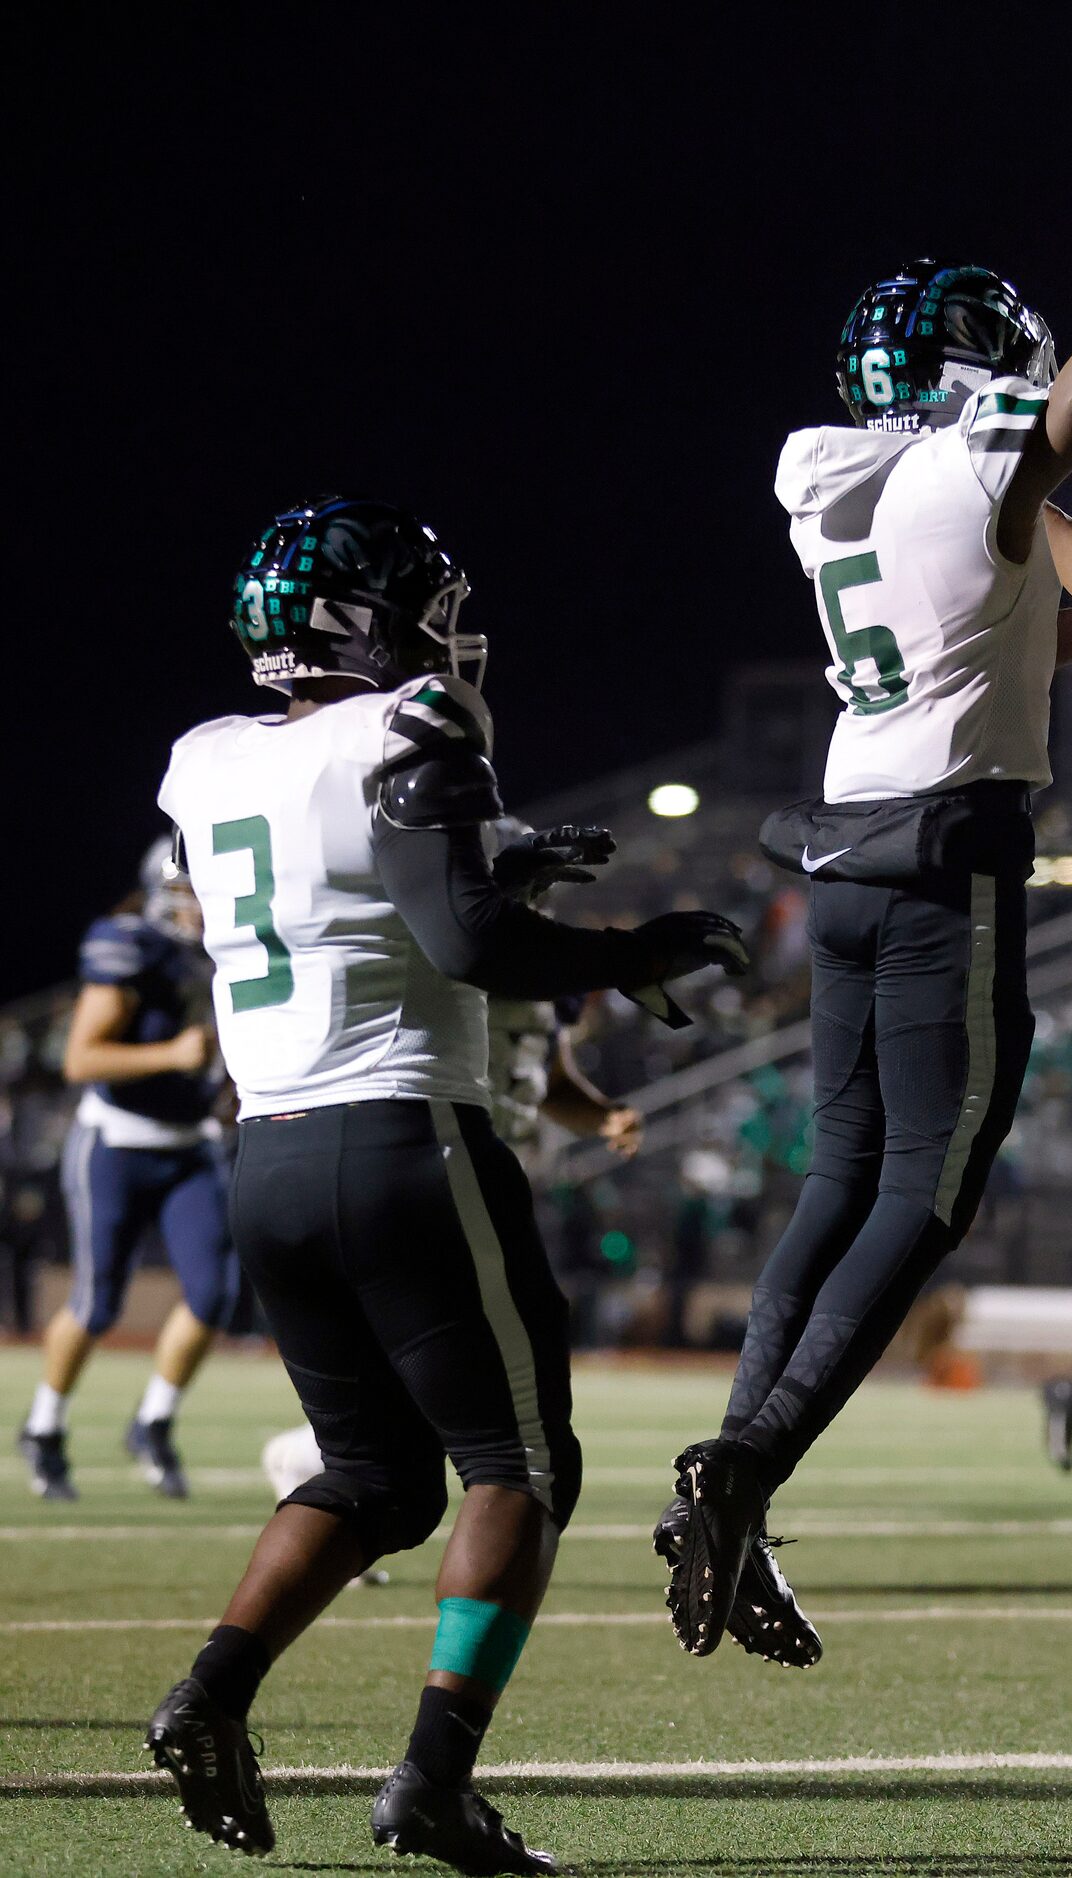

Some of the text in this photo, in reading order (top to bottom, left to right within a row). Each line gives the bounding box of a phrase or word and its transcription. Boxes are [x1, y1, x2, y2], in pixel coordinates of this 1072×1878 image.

[849, 356, 858, 374] B
[893, 349, 907, 366] B
[861, 349, 895, 406] 6
[919, 391, 948, 402] BRT
[867, 413, 919, 433] schutt
[303, 537, 316, 549] B
[298, 557, 313, 571] B
[242, 579, 269, 641] 3
[819, 550, 910, 716] 6
[253, 651, 295, 672] schutt
[212, 814, 295, 1014] 3
